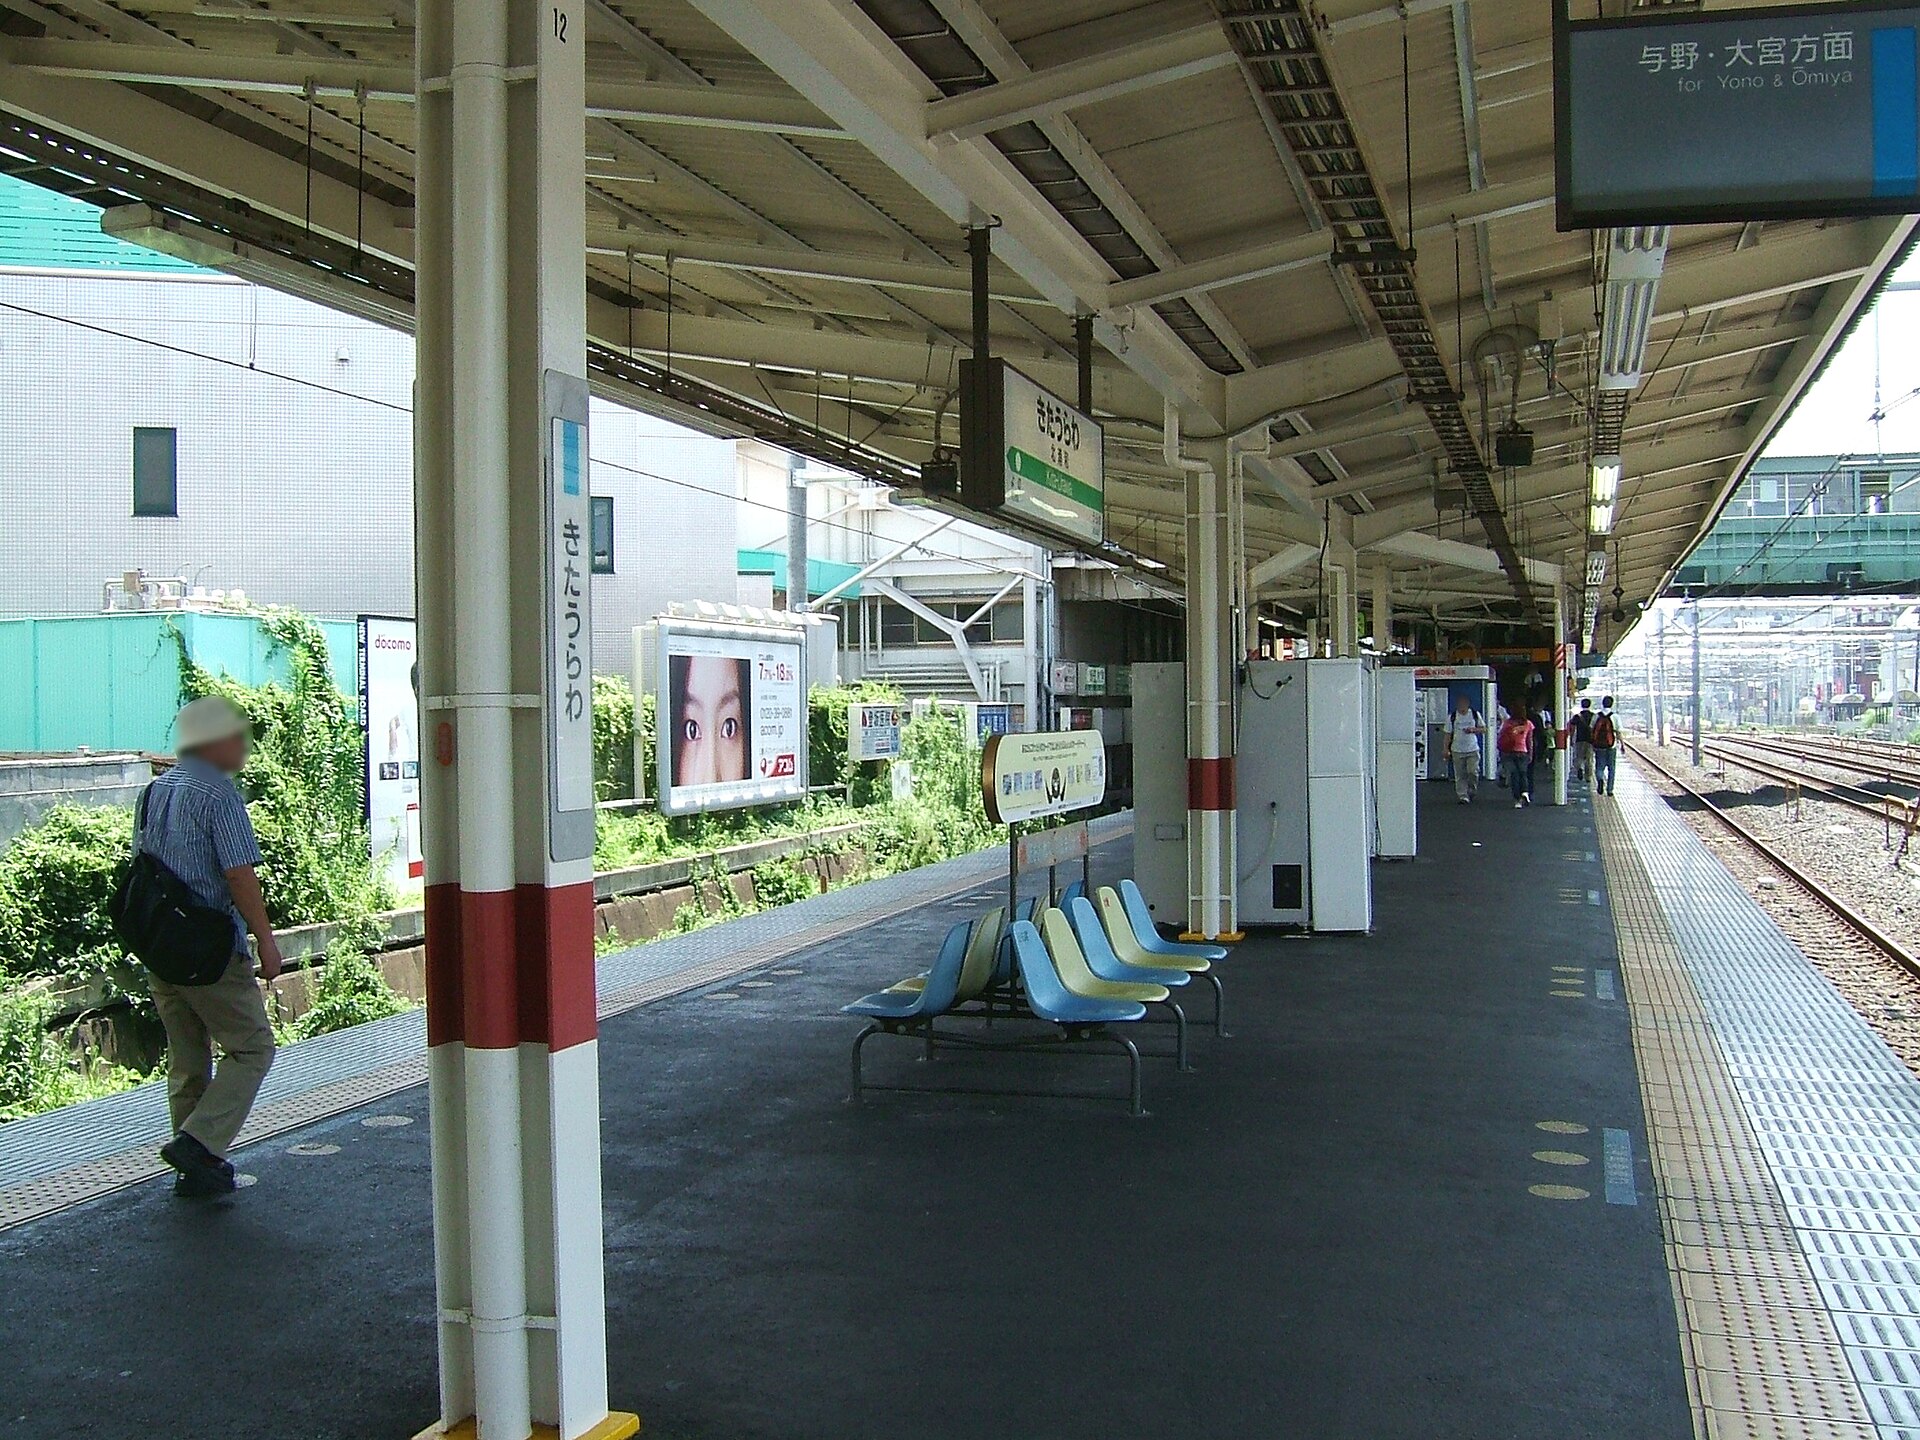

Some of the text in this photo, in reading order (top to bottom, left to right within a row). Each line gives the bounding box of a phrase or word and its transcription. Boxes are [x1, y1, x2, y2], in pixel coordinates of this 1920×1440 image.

[553, 7, 568, 44] 12
[1638, 31, 1853, 73] 与野・大宮方面
[1679, 76, 1702, 92] for
[1718, 74, 1764, 90] Yono
[1774, 74, 1783, 87] &
[1036, 395, 1081, 451] きたうらわ
[563, 518, 583, 722] きたうらわ
[375, 634, 411, 650] docomo
